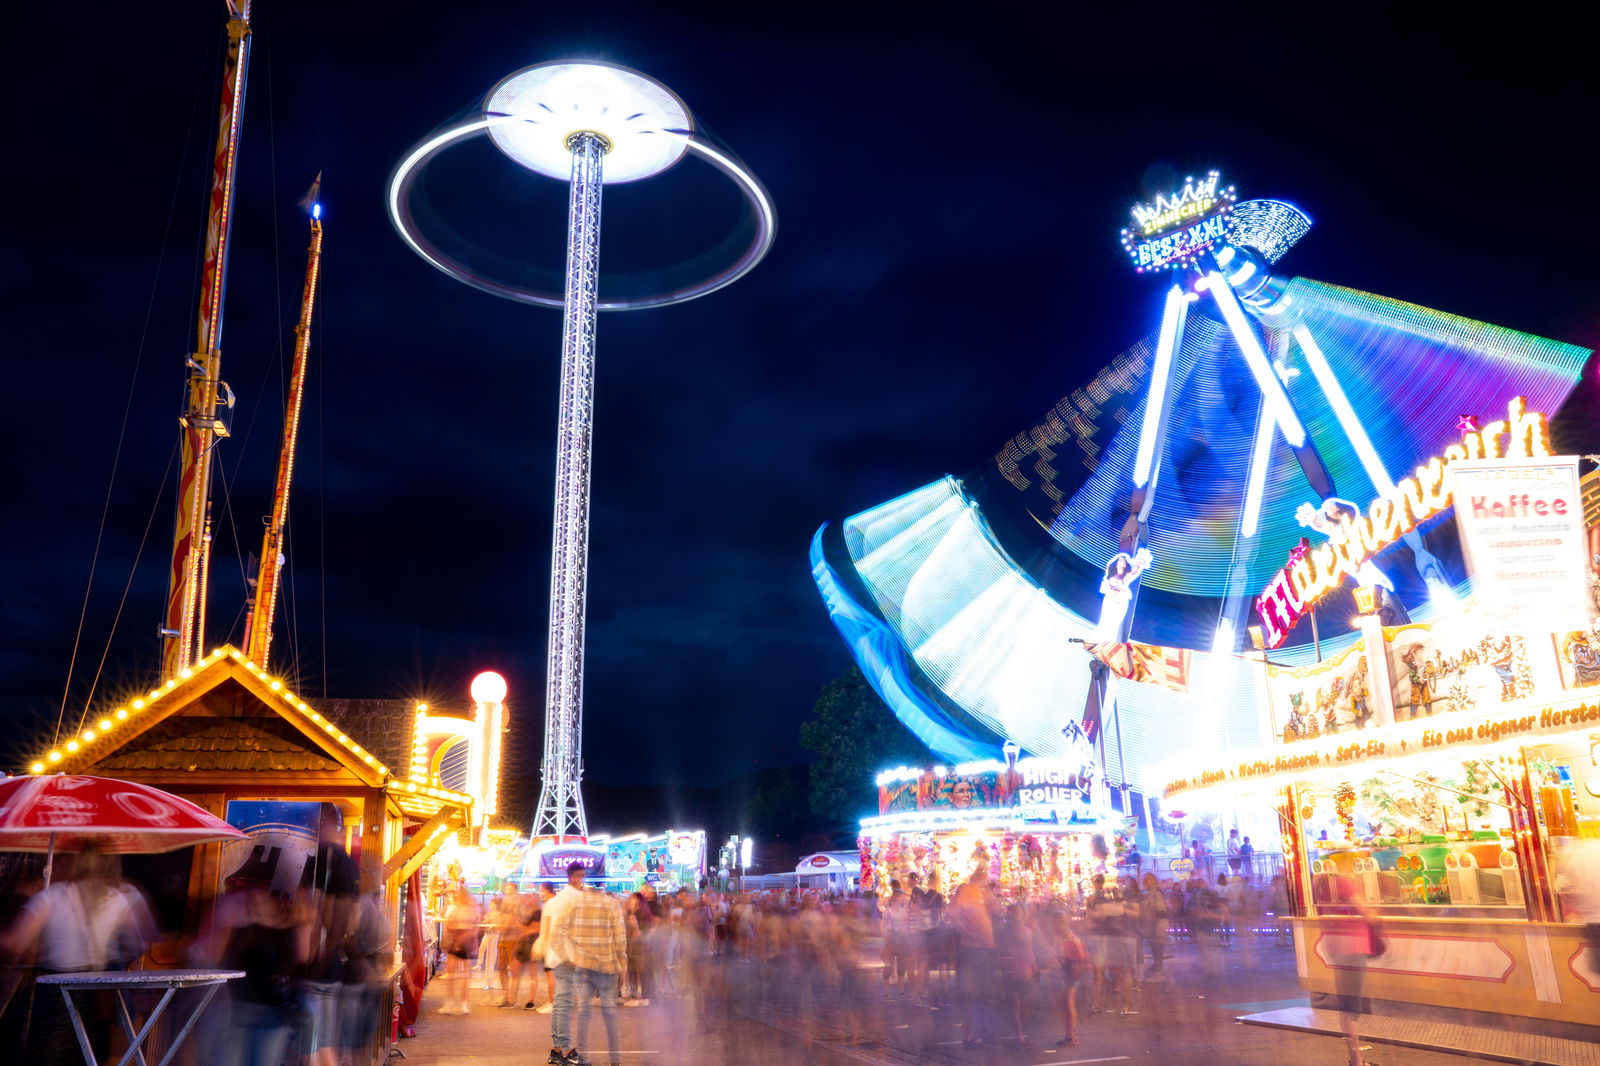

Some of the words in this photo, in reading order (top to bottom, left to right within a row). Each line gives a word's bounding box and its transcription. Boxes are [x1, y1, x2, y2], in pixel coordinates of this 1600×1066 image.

[1143, 198, 1212, 235] ZINNECKER
[1138, 232, 1183, 266] BEST
[1187, 214, 1229, 247] XXL
[1471, 494, 1568, 518] Kaffee
[1336, 739, 1385, 762] Soft-Eis
[1422, 729, 1442, 748] Eis
[1446, 726, 1474, 745] aus
[1477, 714, 1537, 742] eigener
[1023, 767, 1069, 786] HIGH
[1020, 786, 1083, 805] ROLLER
[647, 874, 658, 882] WC
